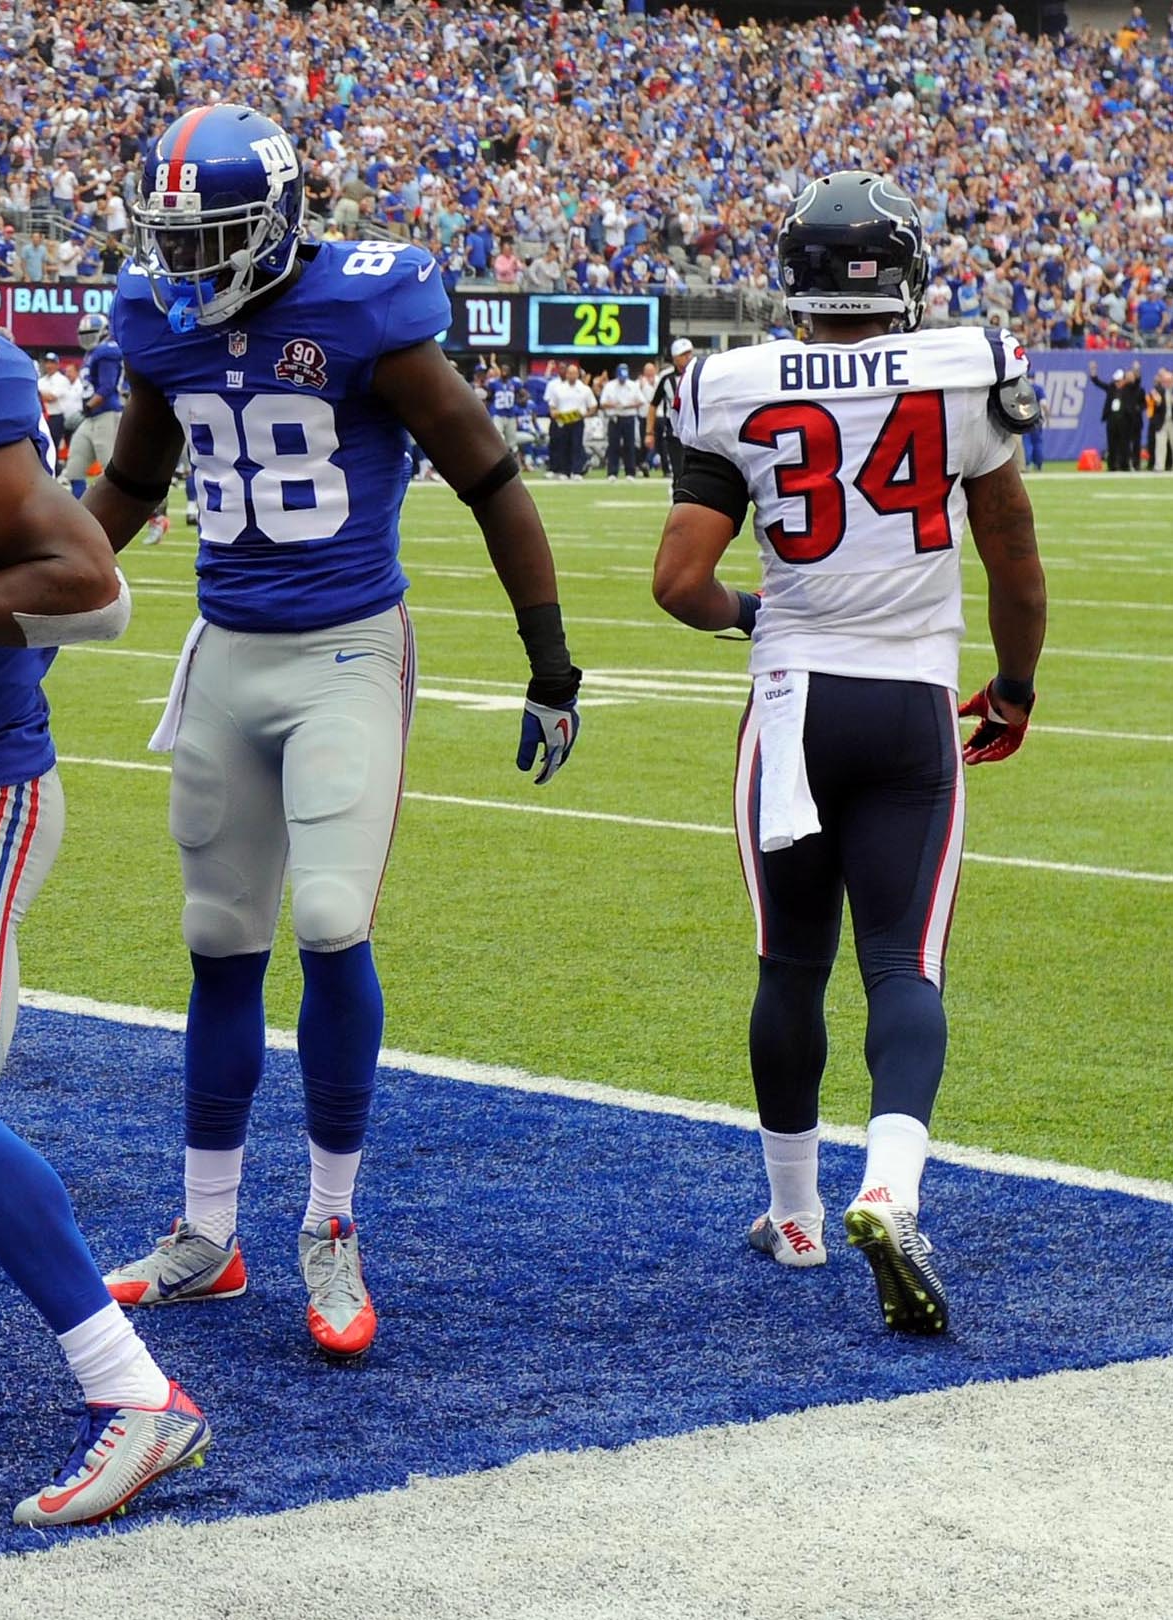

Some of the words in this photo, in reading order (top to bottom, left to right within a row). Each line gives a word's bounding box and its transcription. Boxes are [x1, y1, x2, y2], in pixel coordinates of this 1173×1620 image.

[155, 163, 198, 192] 88
[14, 288, 79, 313] BALL
[808, 302, 872, 310] TEXANS
[573, 303, 622, 346] 25
[292, 342, 315, 365] 90
[780, 350, 909, 391] BOUYE
[494, 390, 515, 409] 20
[174, 393, 350, 545] 88
[739, 390, 958, 565] 34
[858, 1186, 893, 1203] NIKE
[780, 1221, 816, 1256] NIKE
